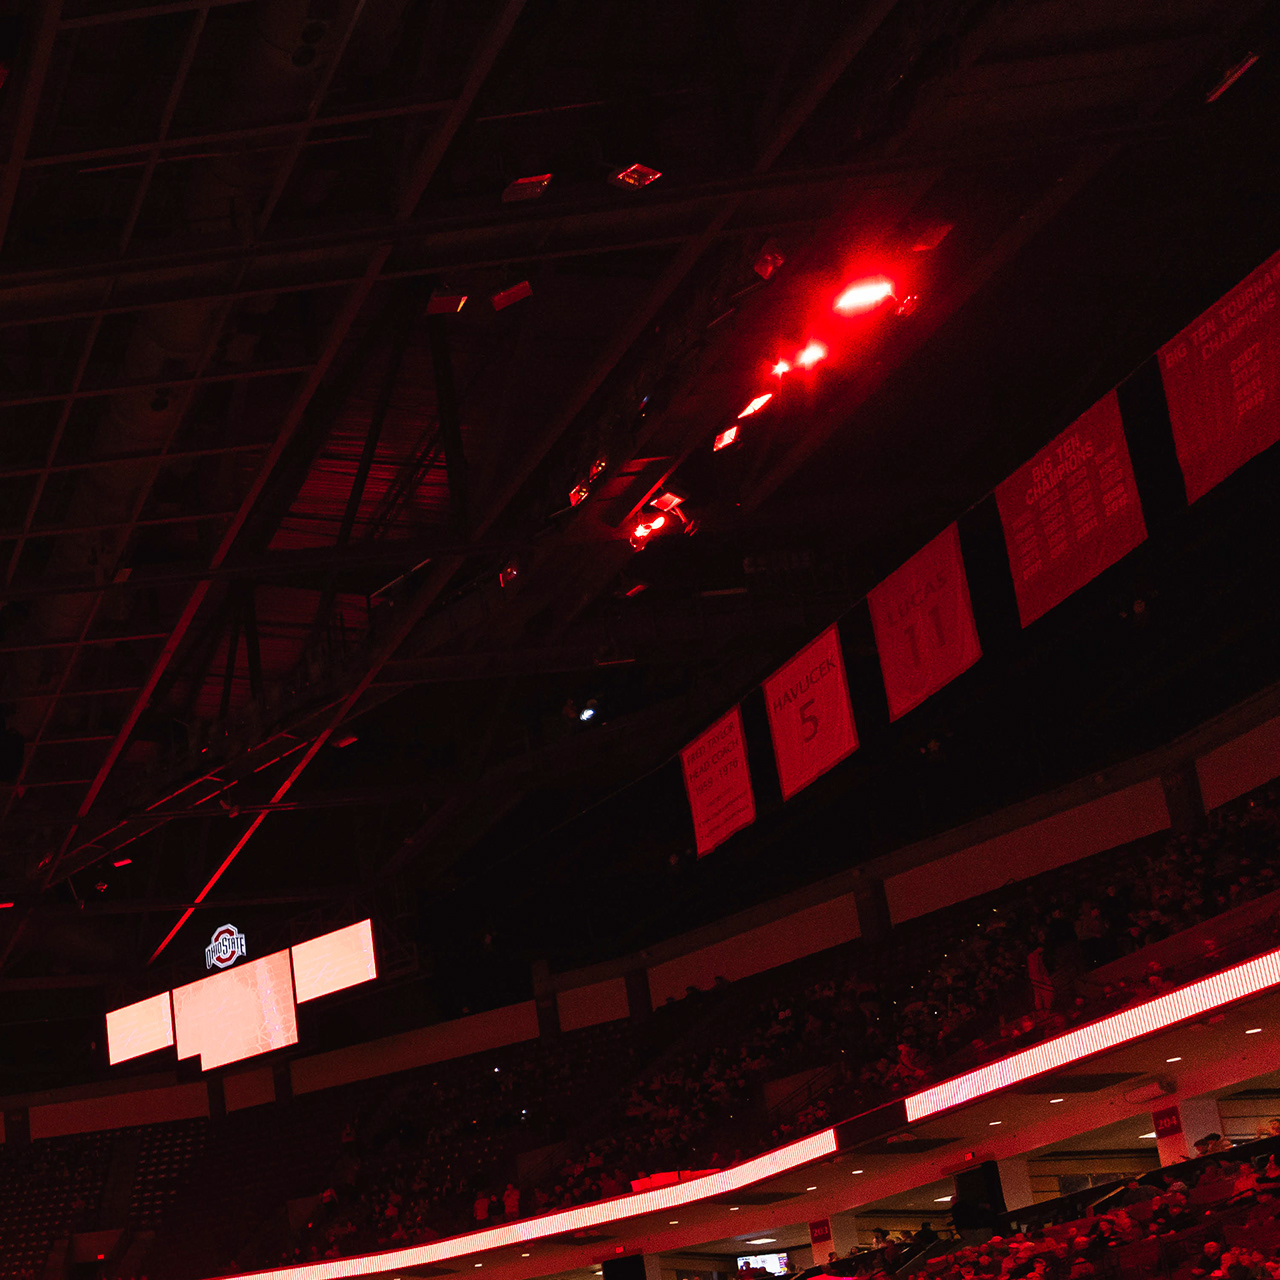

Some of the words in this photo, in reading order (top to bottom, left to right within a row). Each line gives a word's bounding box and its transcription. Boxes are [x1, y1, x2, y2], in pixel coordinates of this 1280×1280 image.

[1191, 318, 1216, 346] TEN
[1201, 291, 1276, 361] CHAMPIONS
[1025, 440, 1095, 506] CHAMPIONS
[1032, 459, 1052, 484] BIG
[1056, 433, 1080, 462] TEN
[887, 569, 948, 627] LUCAS
[903, 603, 946, 667] 11
[773, 656, 836, 714] HAVLICEK
[799, 698, 819, 743] 5
[712, 739, 739, 766] COACH
[1156, 1115, 1177, 1131] 204
[813, 1225, 829, 1238] 203
